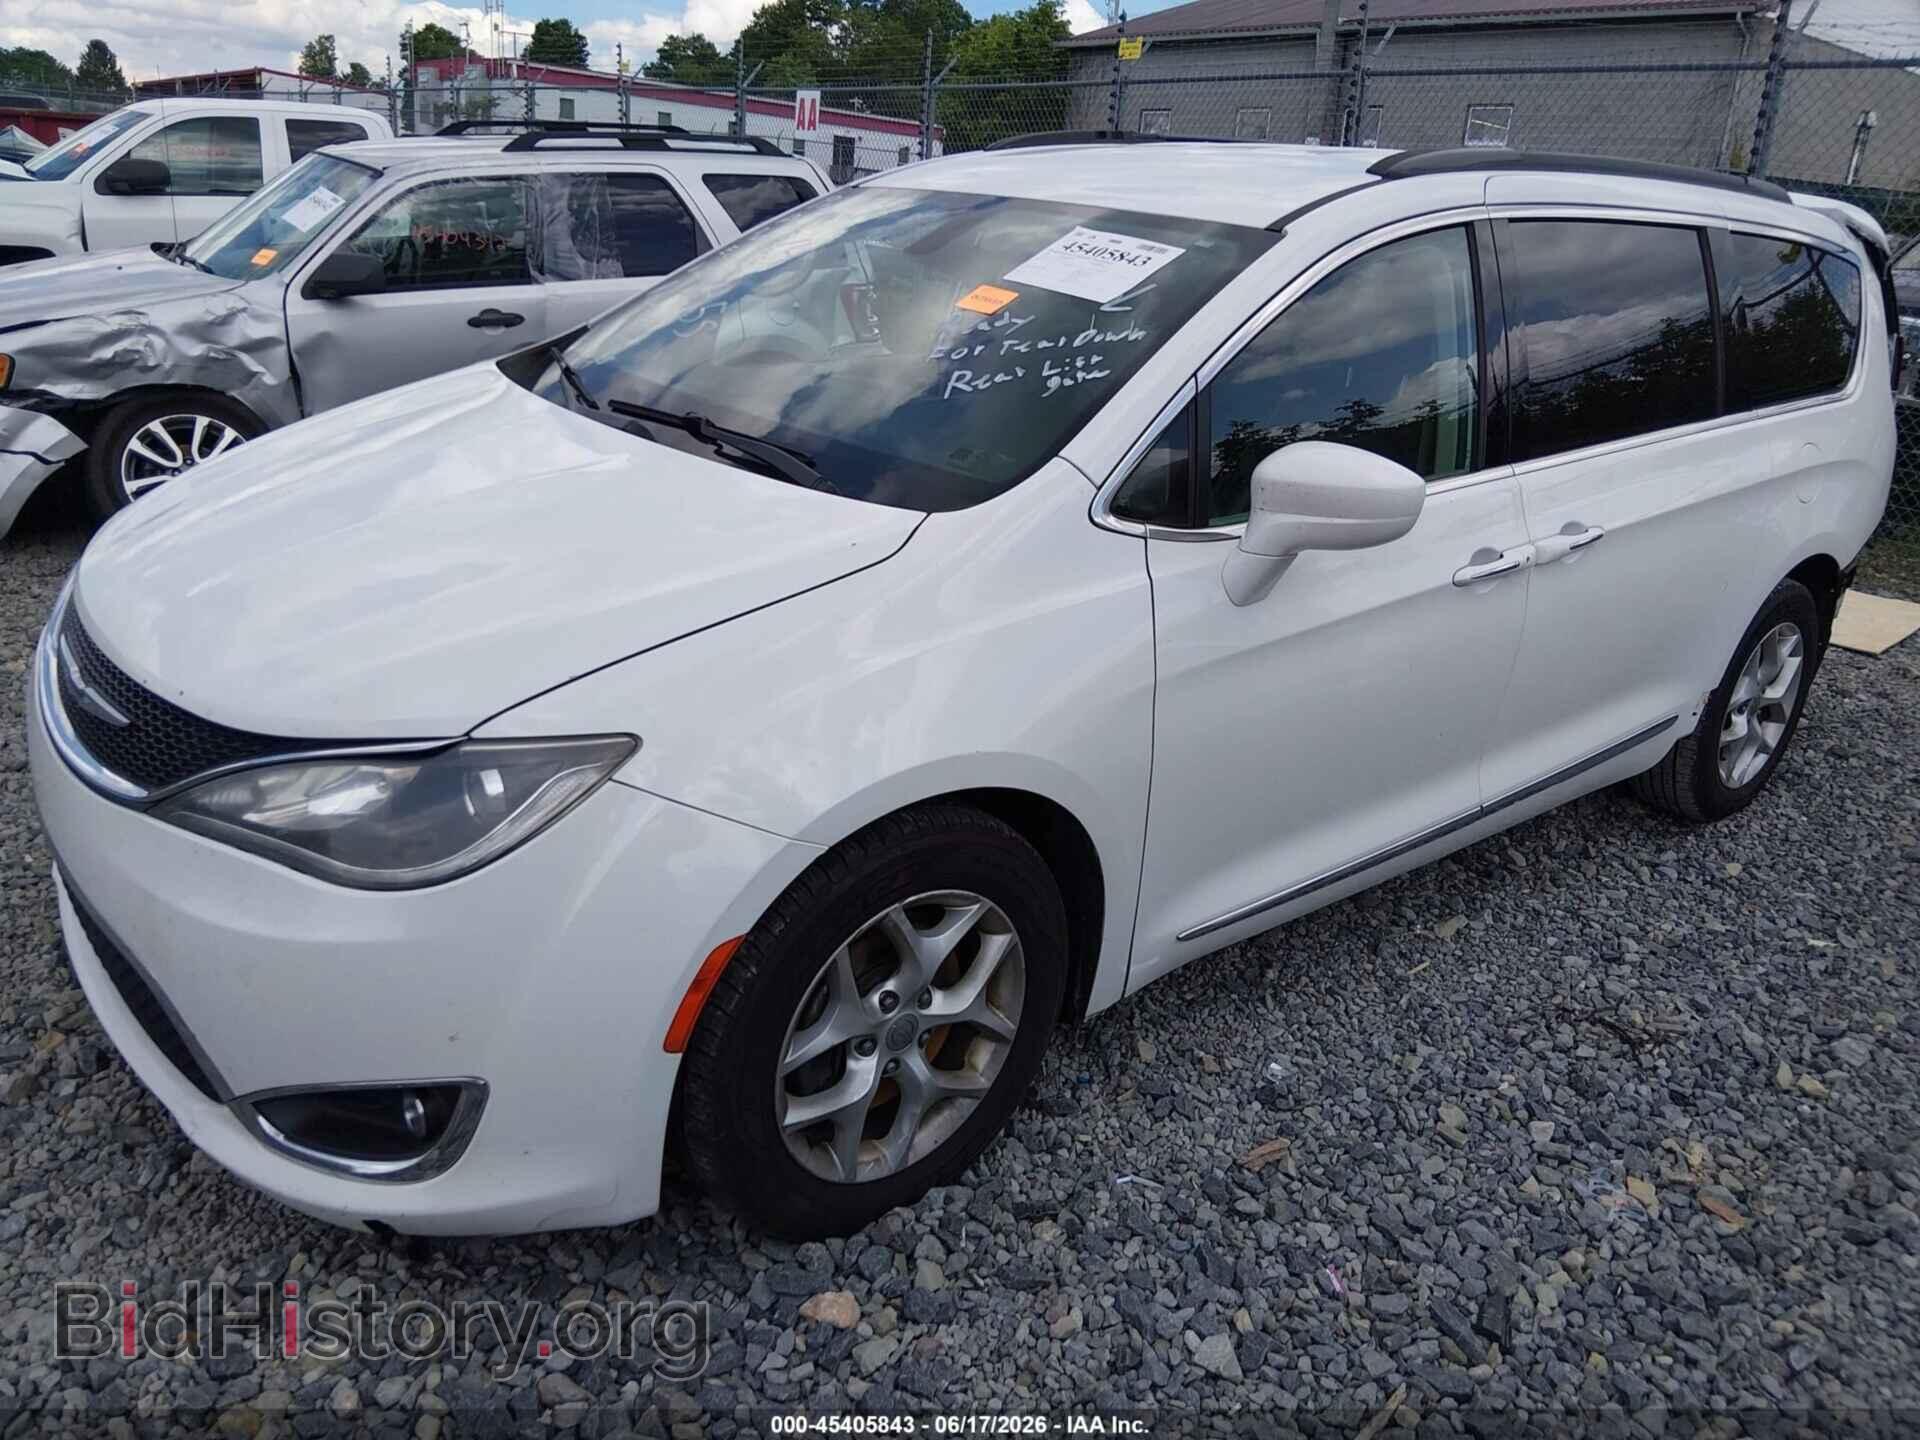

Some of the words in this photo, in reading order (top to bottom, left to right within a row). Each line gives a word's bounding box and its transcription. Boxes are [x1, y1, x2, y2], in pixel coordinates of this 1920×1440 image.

[796, 97, 817, 131] AA
[1062, 241, 1152, 267] 45405843
[944, 366, 1026, 400] Rear
